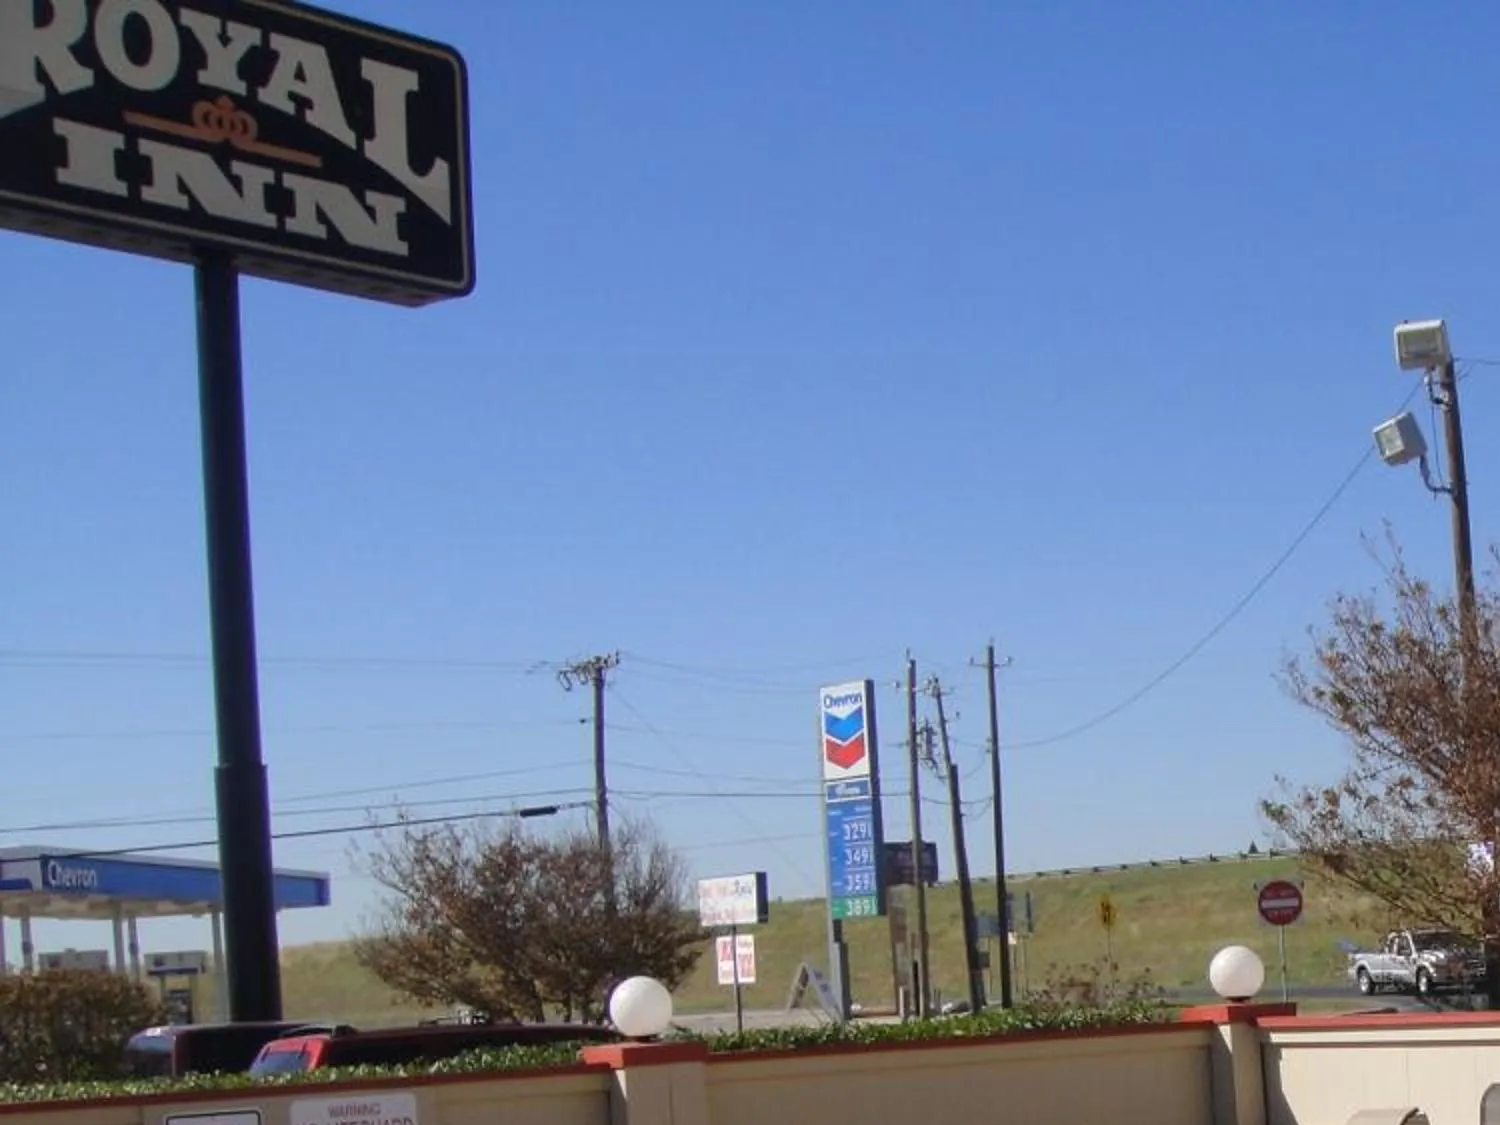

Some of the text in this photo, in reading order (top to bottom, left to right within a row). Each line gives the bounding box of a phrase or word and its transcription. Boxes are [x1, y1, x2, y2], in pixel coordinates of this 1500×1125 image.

[0, 0, 453, 226] ROYAL
[53, 117, 409, 257] INN
[823, 692, 863, 709] Chevron
[47, 860, 98, 889] Chevron
